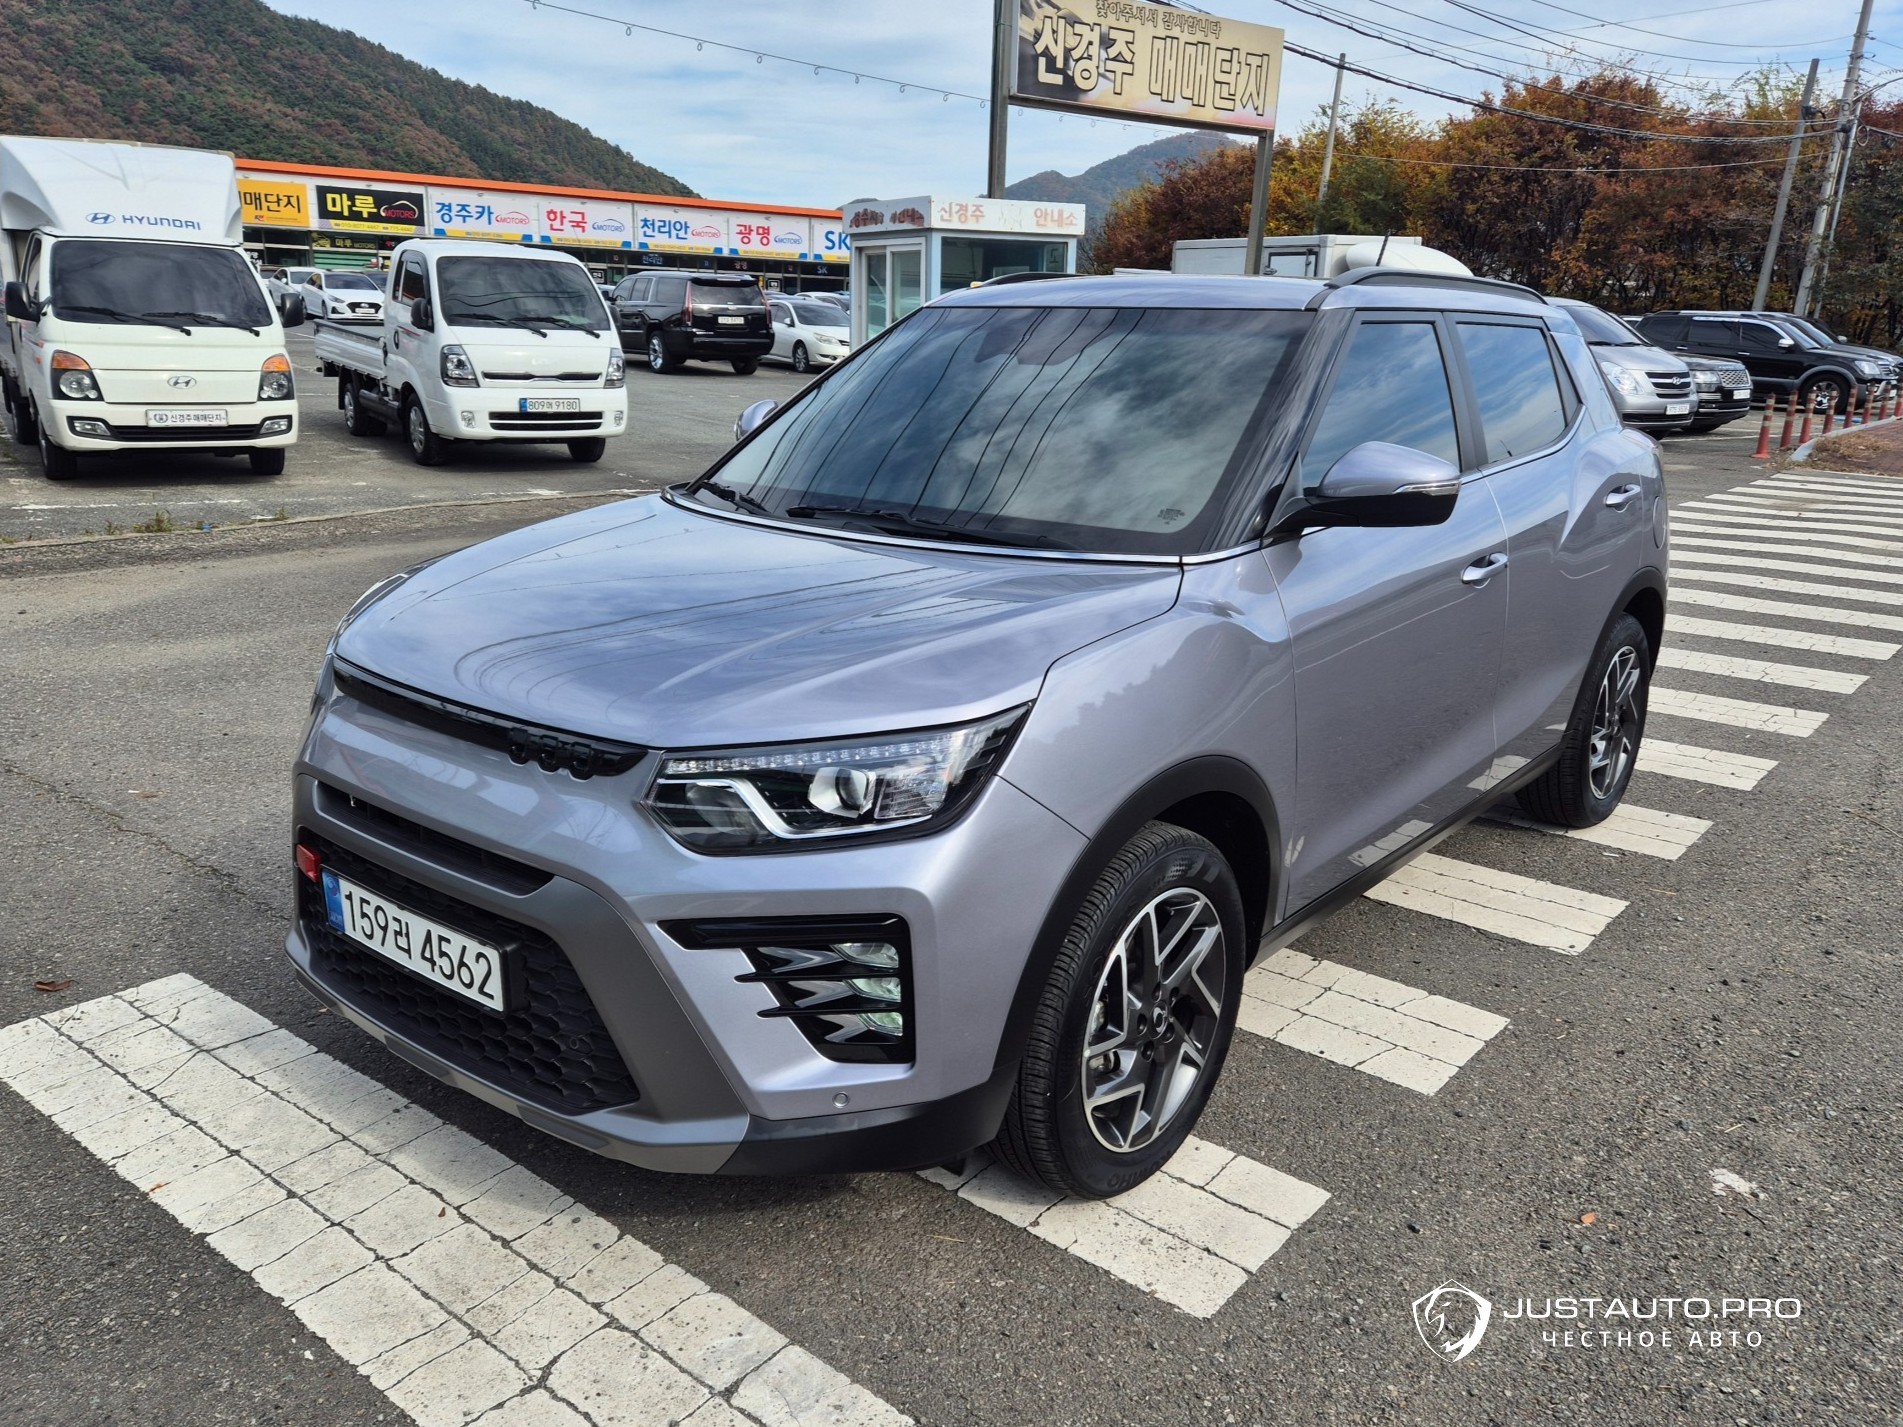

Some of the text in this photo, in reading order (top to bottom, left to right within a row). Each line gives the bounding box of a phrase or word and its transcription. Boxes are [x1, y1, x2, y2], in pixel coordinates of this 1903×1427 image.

[1096, 0, 1222, 39] 찾아주셔서 감사합니다
[1033, 15, 1270, 116] 신경주 매매단지
[238, 190, 301, 213] 매단지
[325, 193, 415, 219] 마루 MOTORS
[122, 215, 201, 230] HYUNDAI
[435, 202, 528, 225] 경주카 MOTORS
[546, 209, 623, 233] 한국 MOTORS
[938, 202, 986, 223] 신경주
[1033, 207, 1078, 228] 안내소
[640, 217, 720, 240] 천리안 MOTORS
[735, 224, 801, 246] 광명 MOTORS
[824, 230, 851, 251] SK
[554, 400, 577, 410] 9180
[170, 413, 221, 423] 신경주매매단지
[344, 890, 494, 1001] 159러 4562
